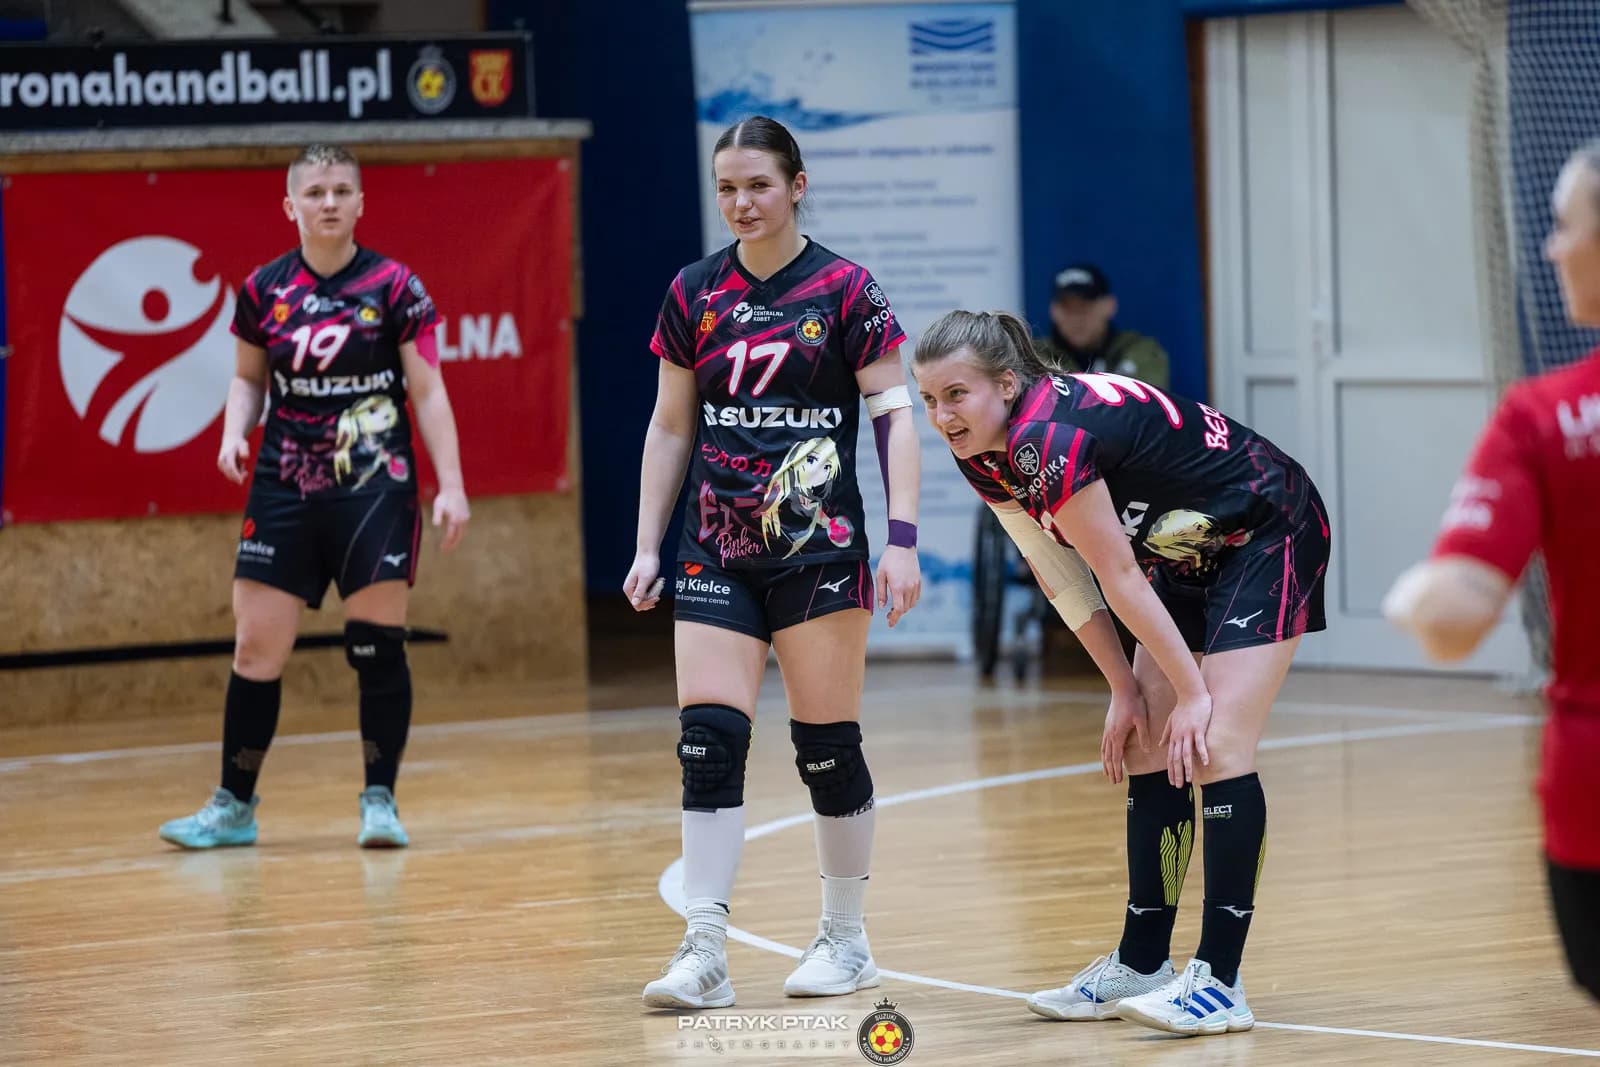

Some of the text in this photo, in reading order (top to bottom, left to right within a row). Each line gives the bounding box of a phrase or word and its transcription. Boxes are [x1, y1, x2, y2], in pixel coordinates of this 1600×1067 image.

[0, 48, 392, 118] ronahandball.pl
[291, 324, 350, 372] 19
[725, 340, 791, 398] 17
[717, 406, 843, 429] SUZUKI
[687, 577, 731, 595] Kielce
[682, 744, 707, 756] SELECT
[806, 758, 836, 771] SELECT
